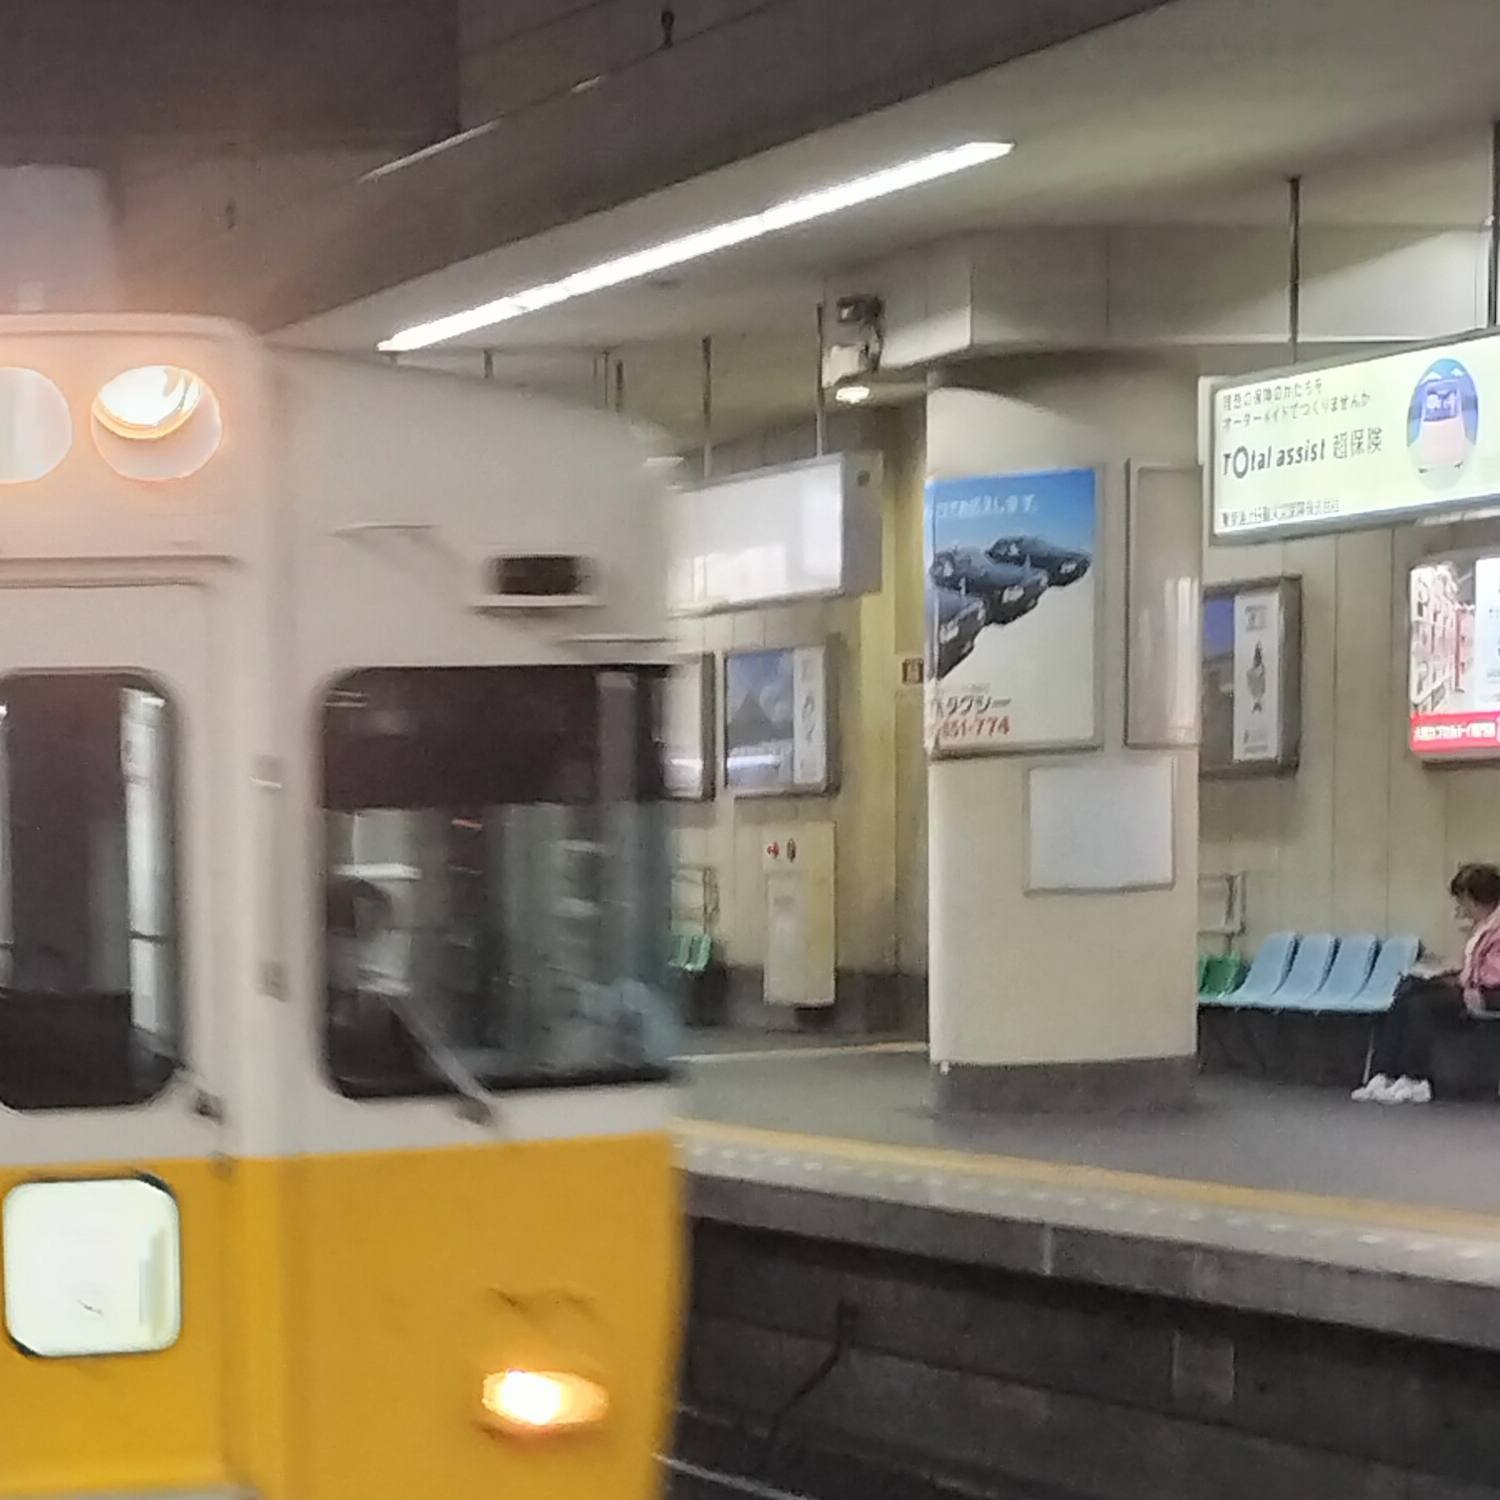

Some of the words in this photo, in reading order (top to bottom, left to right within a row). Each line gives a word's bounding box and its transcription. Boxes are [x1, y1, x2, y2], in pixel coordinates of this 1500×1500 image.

[1276, 438, 1326, 467] assist
[1332, 426, 1383, 460] 超保険
